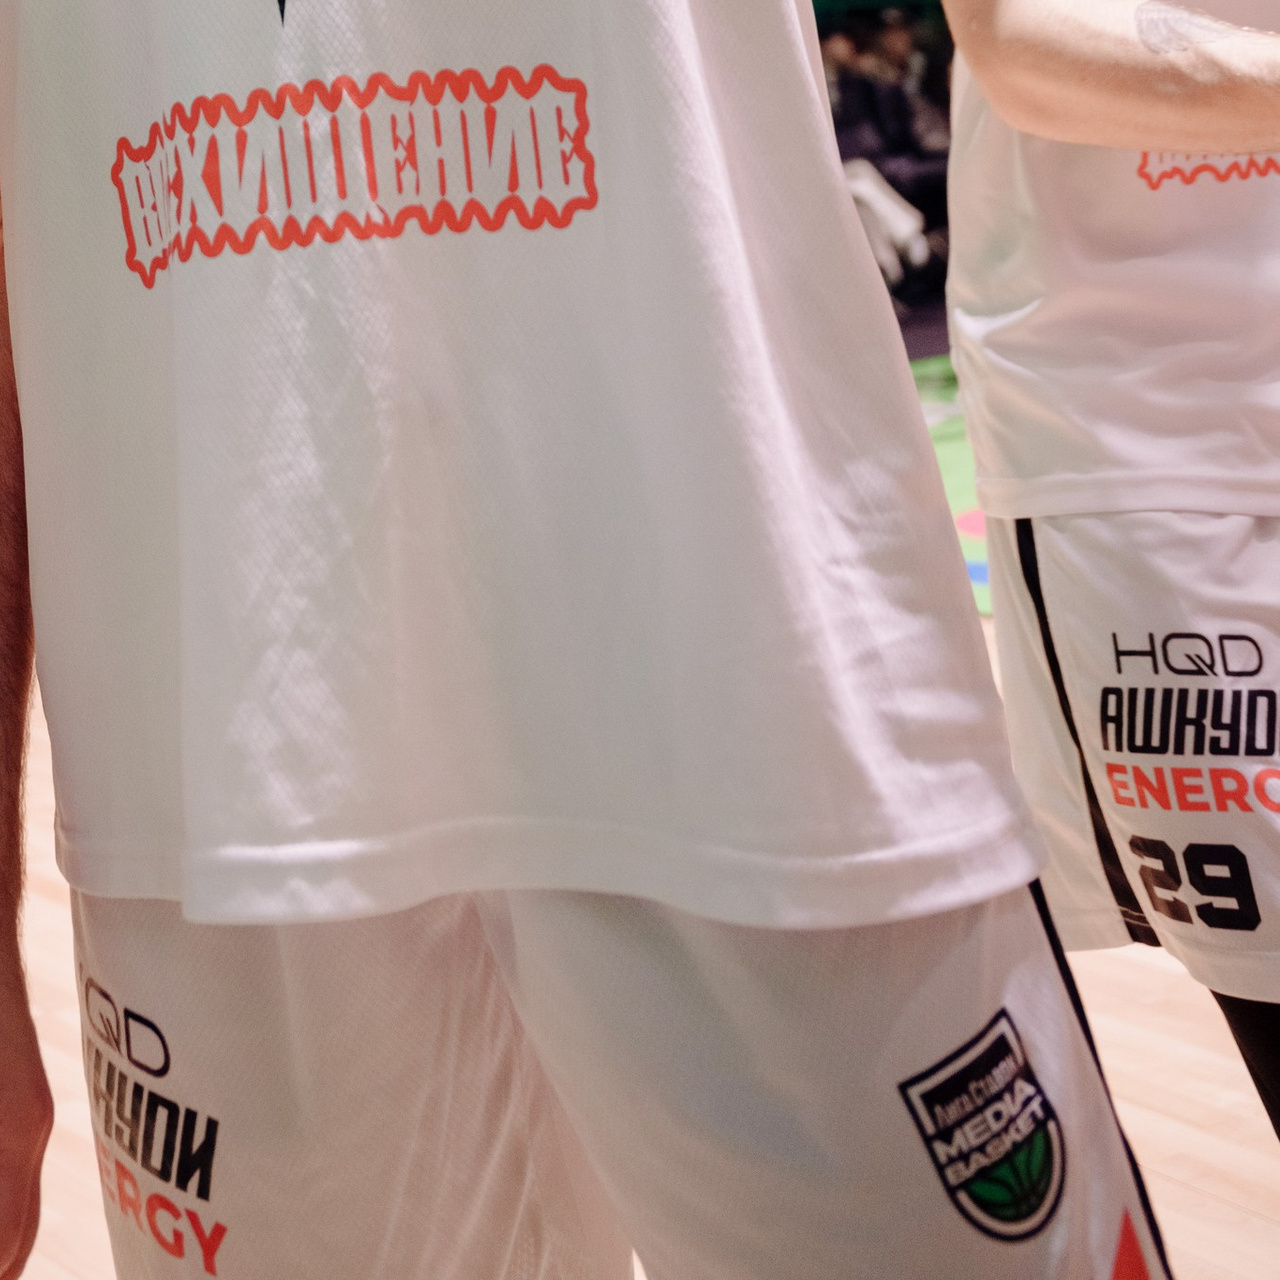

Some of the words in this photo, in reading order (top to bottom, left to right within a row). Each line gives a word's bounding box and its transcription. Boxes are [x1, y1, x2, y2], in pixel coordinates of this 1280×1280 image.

[1112, 631, 1264, 677] HQD
[1129, 834, 1262, 931] 29
[80, 964, 171, 1078] QD
